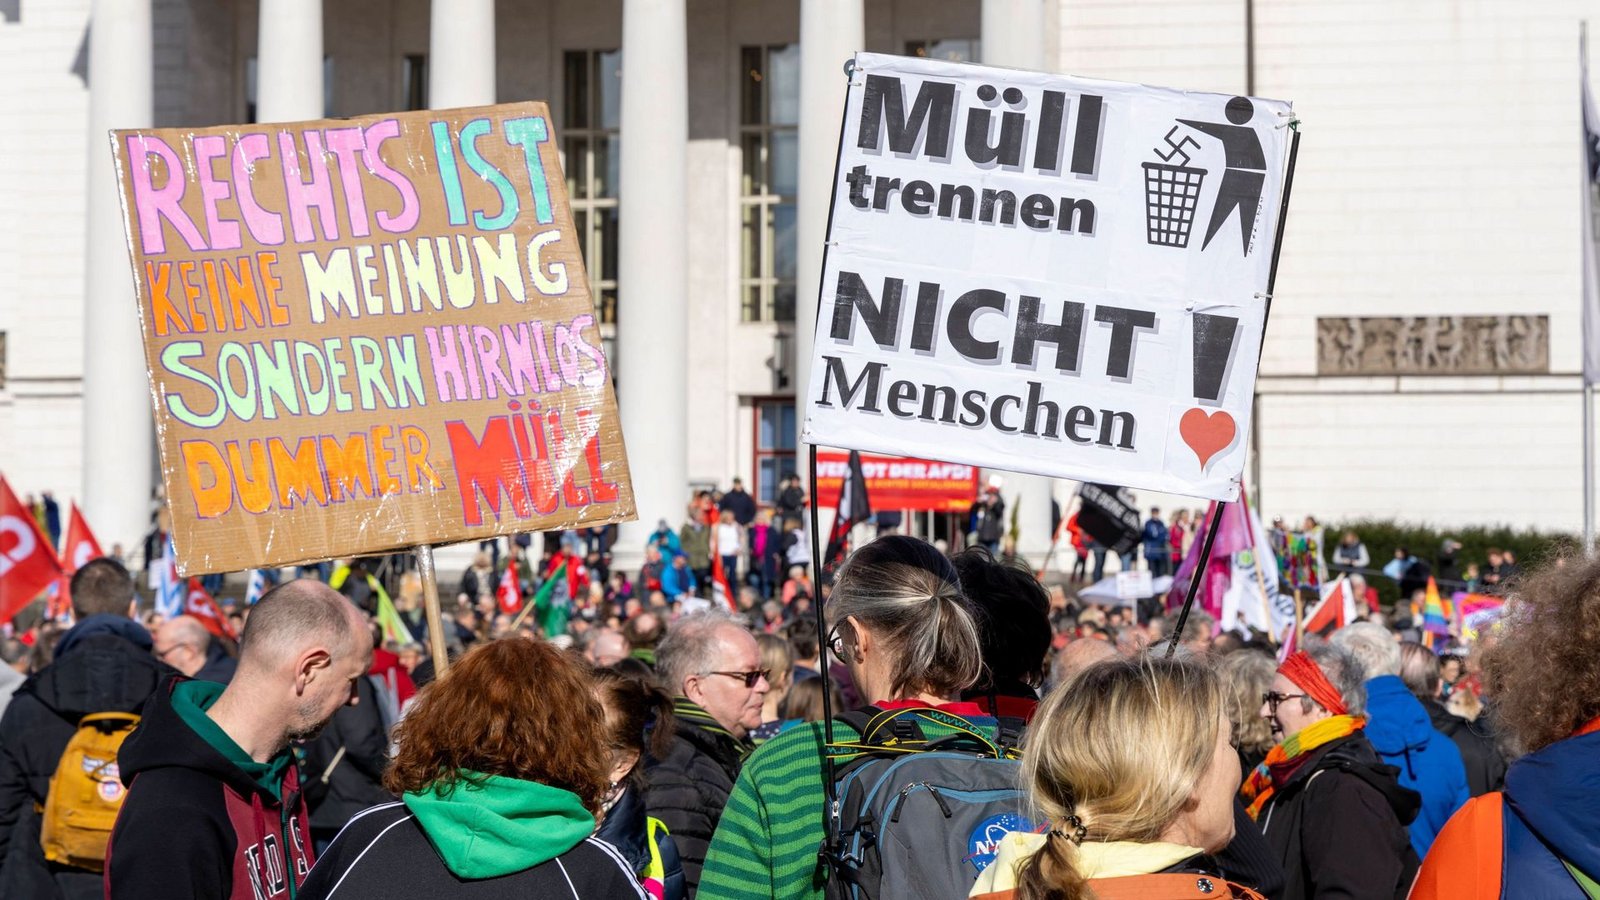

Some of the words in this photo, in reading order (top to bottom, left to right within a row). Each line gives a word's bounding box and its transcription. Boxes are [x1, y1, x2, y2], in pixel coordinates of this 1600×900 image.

[857, 74, 1106, 179] Müll
[126, 118, 420, 255] RECHTS
[431, 115, 554, 231] IST
[846, 165, 1097, 237] trennen
[144, 251, 291, 337] KEINE
[300, 230, 569, 324] MEINUNG
[830, 271, 1157, 381] NICHT
[160, 334, 427, 429] SONDERN
[424, 314, 607, 402] HIRNLOS
[815, 355, 1137, 452] Menschen
[180, 425, 447, 519] DUMMER
[445, 400, 619, 526] MÜLL
